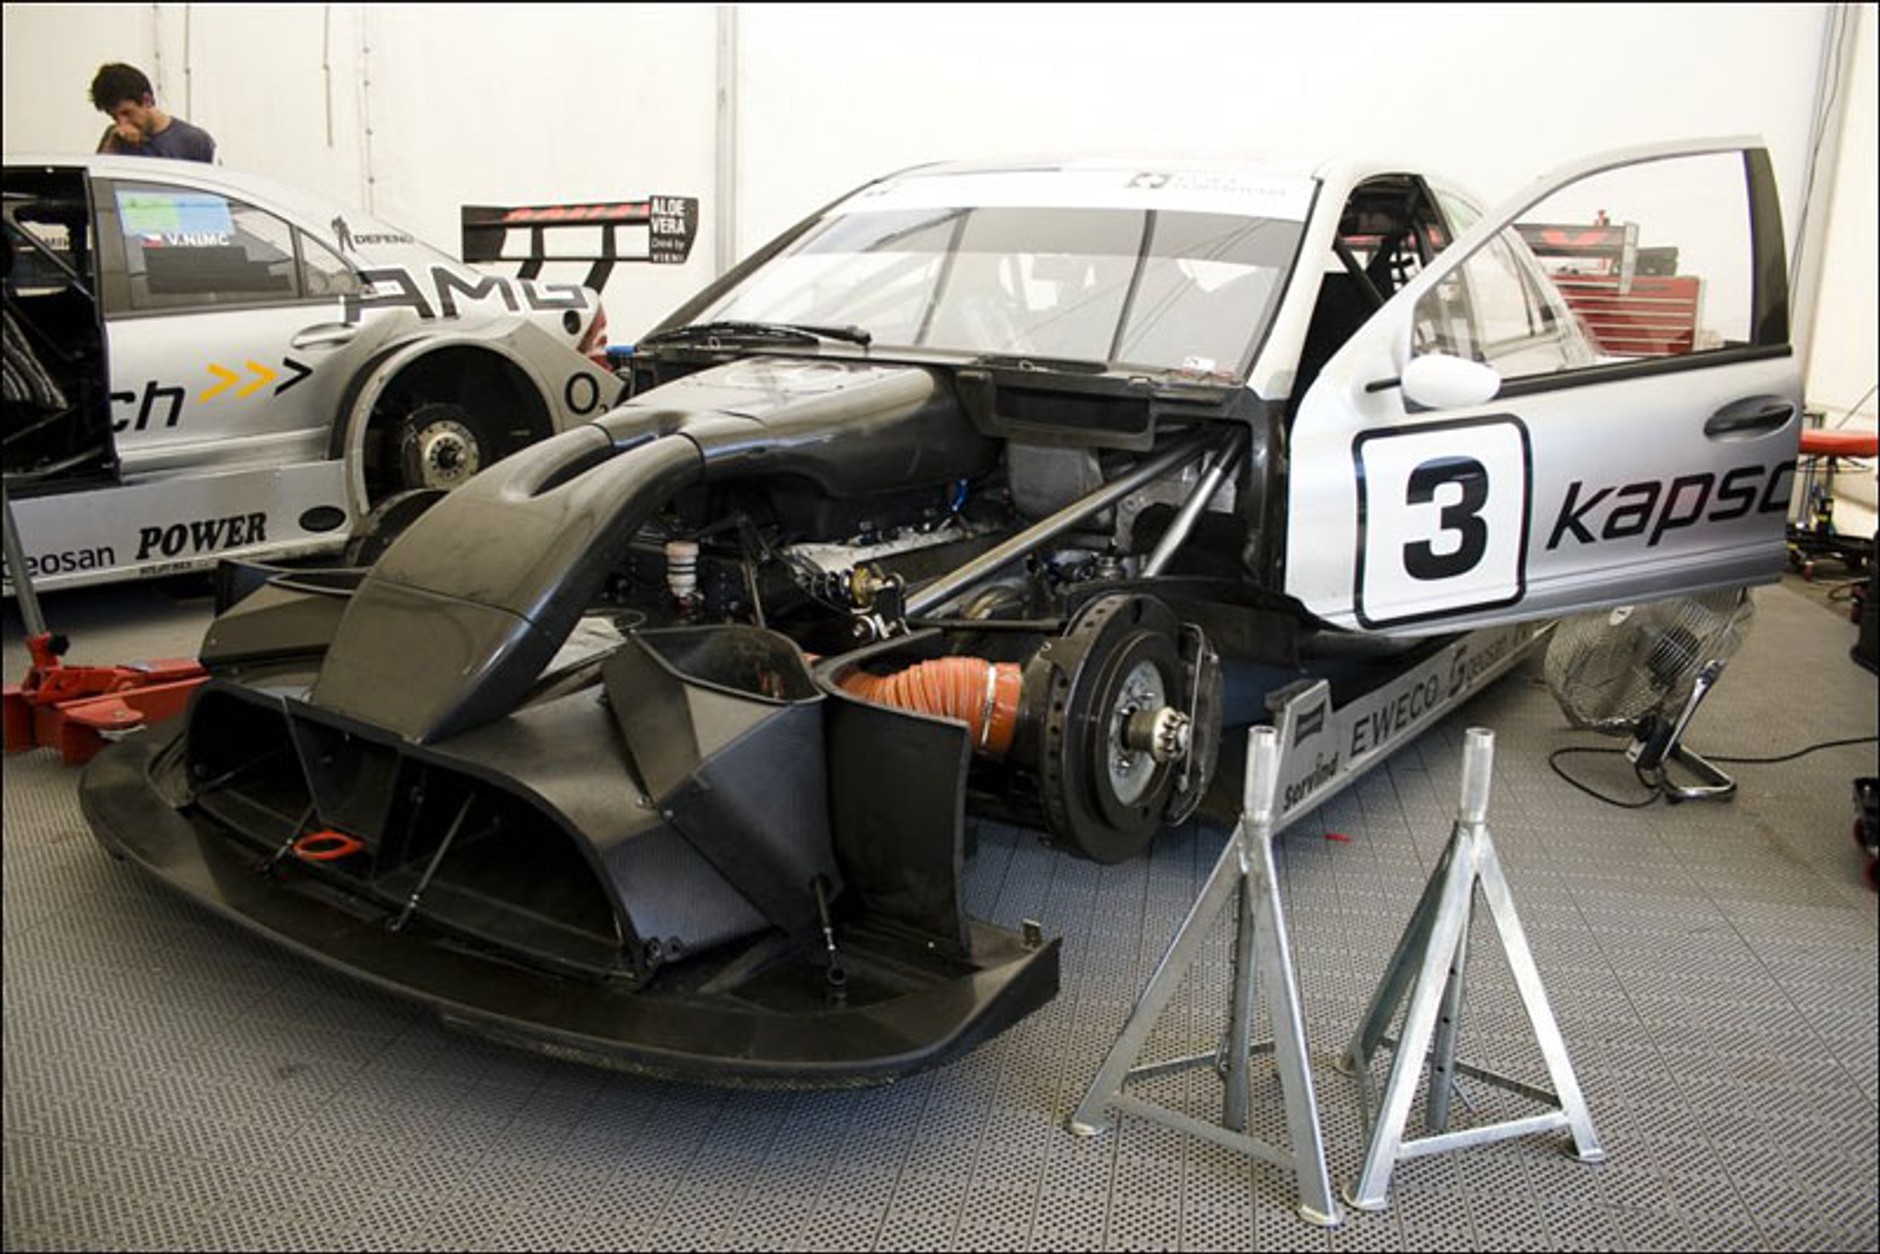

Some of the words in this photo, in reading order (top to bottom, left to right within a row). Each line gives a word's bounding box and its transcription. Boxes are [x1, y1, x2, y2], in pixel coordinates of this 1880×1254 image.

[651, 198, 685, 215] ALOE
[651, 217, 686, 234] VERA
[344, 266, 590, 326] AMG
[135, 511, 267, 561] POWER
[1403, 455, 1489, 581] 3
[1350, 674, 1440, 757] EWECO
